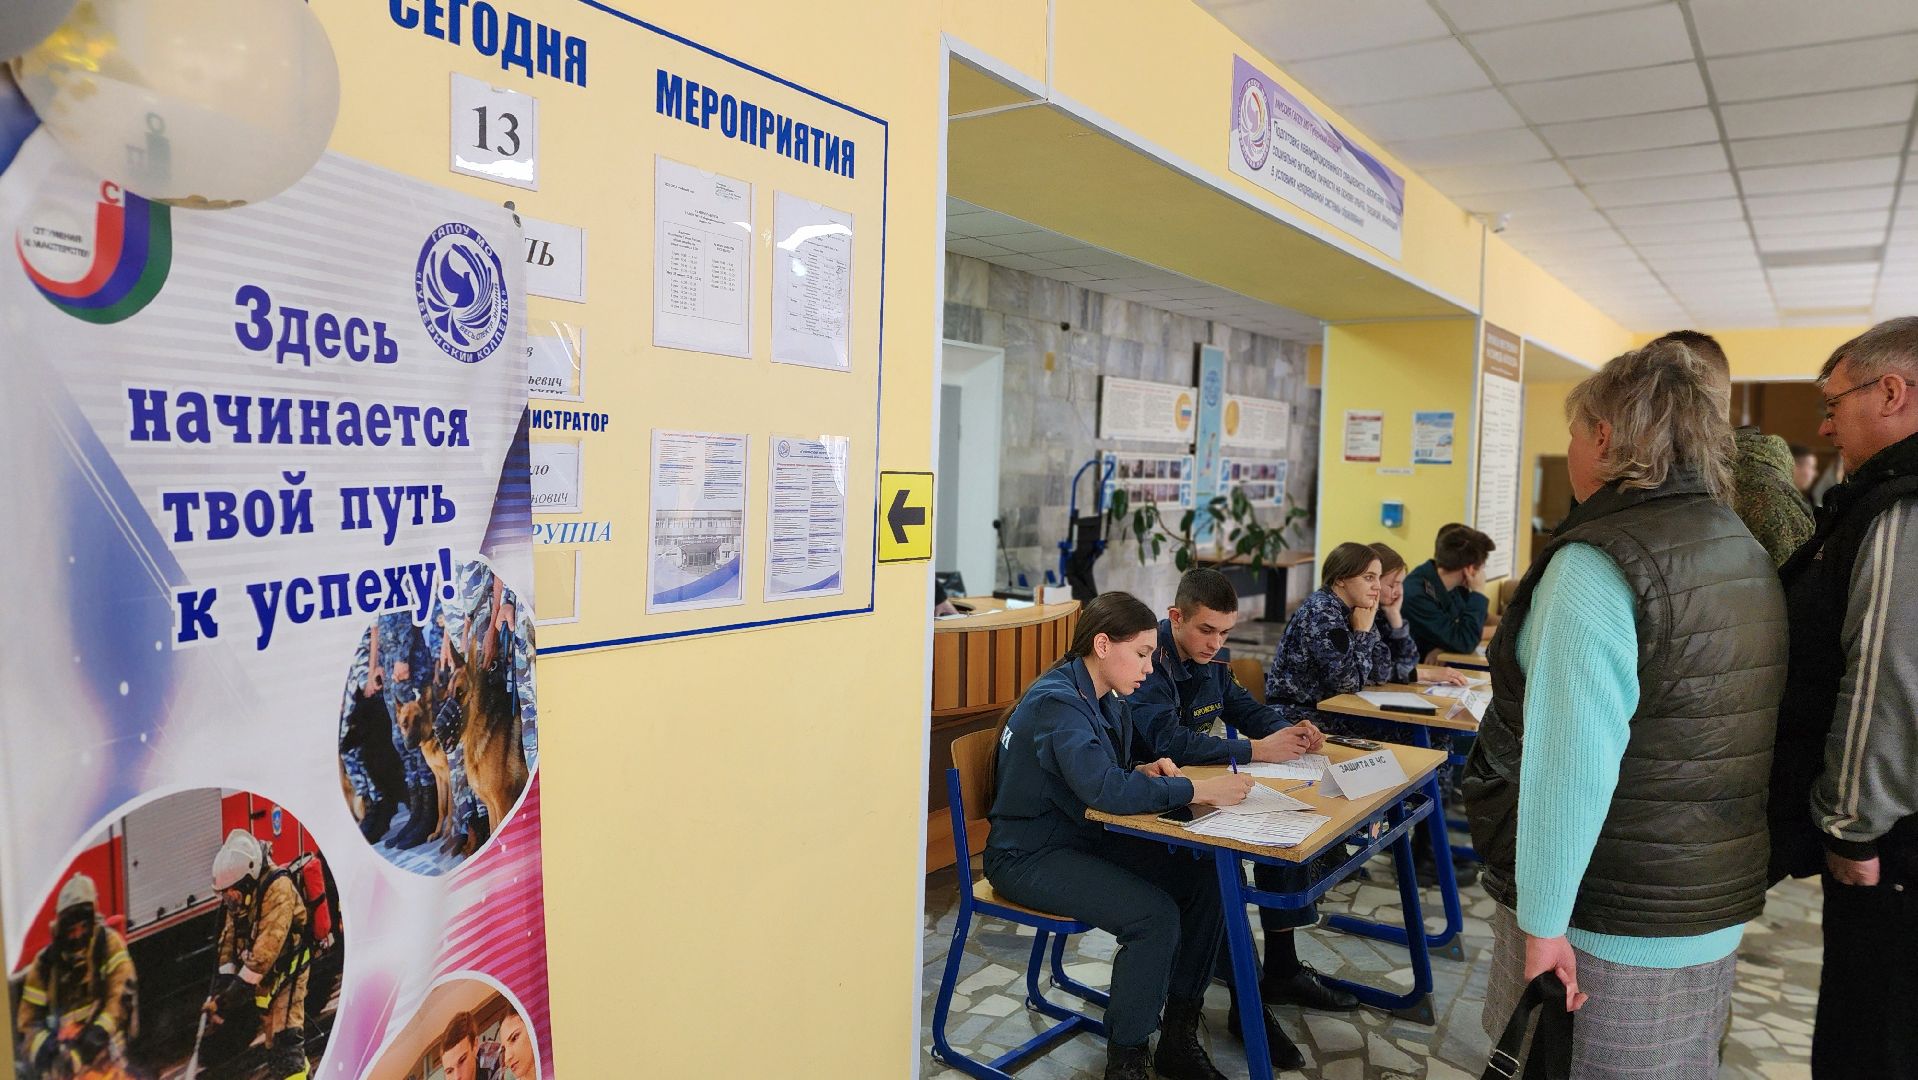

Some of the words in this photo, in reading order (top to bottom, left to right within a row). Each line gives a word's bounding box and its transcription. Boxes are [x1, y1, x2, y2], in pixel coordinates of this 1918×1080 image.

[388, 0, 587, 88] СЕГОДНЯ
[472, 105, 521, 157] 13
[656, 69, 856, 179] МЕРОПРИЯТИЯ
[431, 223, 471, 243] ГАПОУ
[475, 235, 494, 257] МО
[235, 284, 399, 366] Здесь
[128, 388, 471, 448] начинается
[528, 409, 610, 433] ИСТРАТОР
[162, 471, 314, 544] твой
[340, 484, 457, 547] путь
[177, 587, 219, 643] к
[246, 548, 456, 651] успеху!
[1339, 760, 1369, 774] ЗАЩИТА
[1369, 758, 1376, 767] В
[1375, 755, 1386, 765] ЧС
